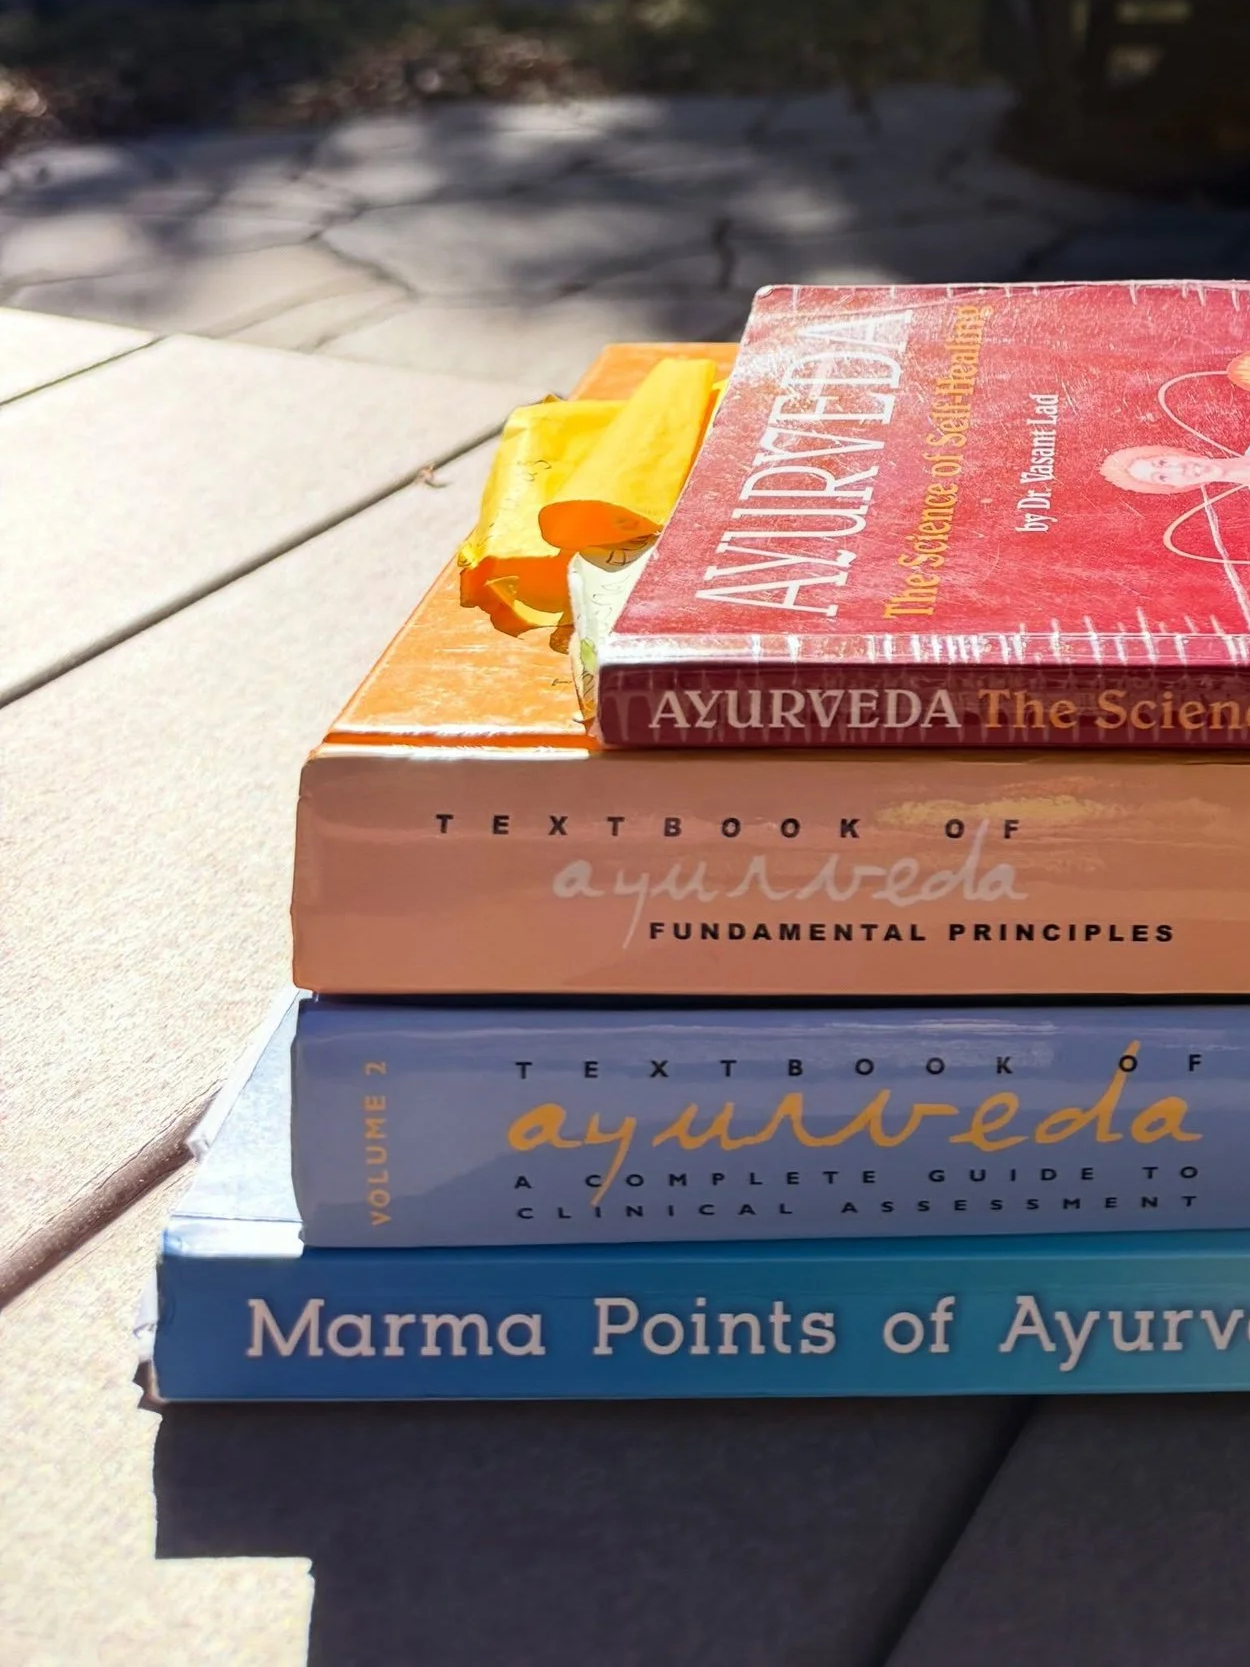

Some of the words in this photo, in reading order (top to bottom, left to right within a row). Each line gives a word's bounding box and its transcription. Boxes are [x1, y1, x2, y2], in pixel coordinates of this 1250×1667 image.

[926, 303, 994, 448] Self-Healing
[1026, 392, 1059, 425] Lad
[695, 309, 914, 617] AYURVEDA
[921, 452, 964, 478] of
[1020, 427, 1057, 485] Vasant
[1017, 487, 1052, 510] Dr.
[898, 482, 958, 568] Science
[1015, 514, 1058, 533] by
[883, 571, 941, 619] The
[648, 688, 962, 730] AYURVEDA
[978, 689, 1078, 730] The
[435, 813, 861, 840] TEXTBOOK
[943, 818, 1020, 841] OF
[552, 818, 1029, 949] ayurveda
[648, 920, 928, 943] FUNDAMENTAL
[948, 921, 1175, 943] PRINCIPLES
[365, 1061, 387, 1076] 2
[514, 1055, 1015, 1080] TEXTBOOK
[1116, 1053, 1203, 1076] OF
[507, 1039, 1204, 1206] ayurveda
[365, 1095, 392, 1226] VOLUME
[513, 1174, 533, 1190] A
[585, 1168, 877, 1190] COMPLETE
[928, 1165, 1096, 1183] GUIDE
[1141, 1164, 1200, 1180] TO
[516, 1201, 794, 1220] CLINICAL
[840, 1194, 1199, 1215] ASSESSMENT
[246, 1296, 546, 1359] Marma
[592, 1295, 838, 1357] Points
[880, 1296, 956, 1356] of
